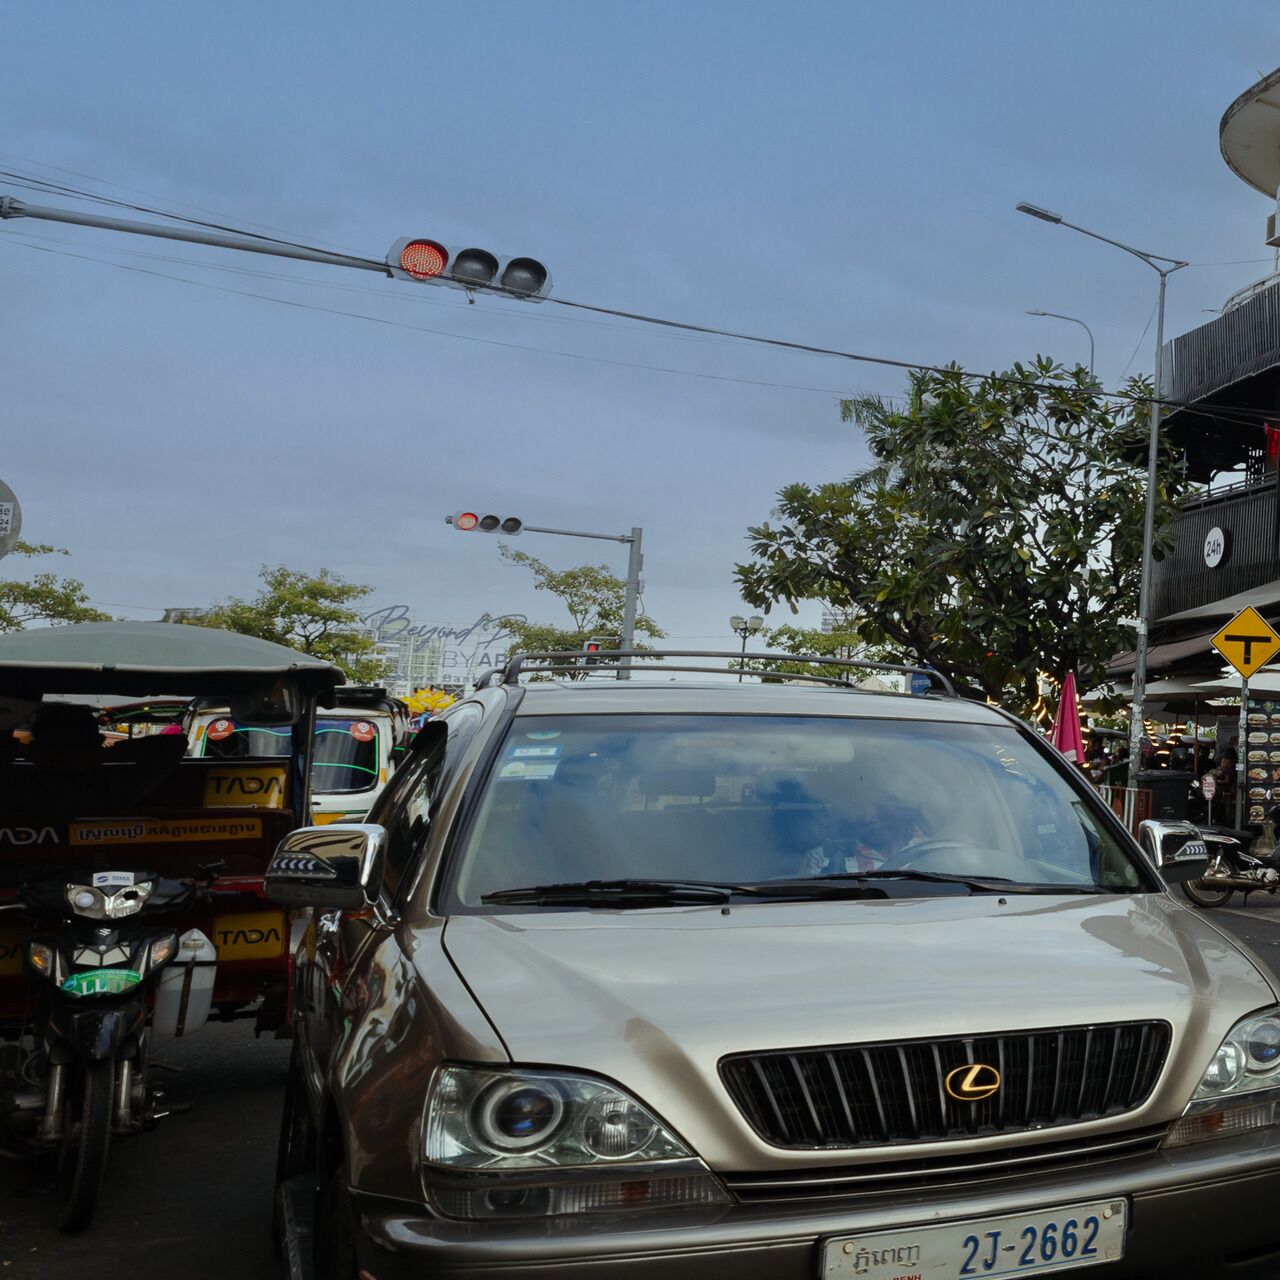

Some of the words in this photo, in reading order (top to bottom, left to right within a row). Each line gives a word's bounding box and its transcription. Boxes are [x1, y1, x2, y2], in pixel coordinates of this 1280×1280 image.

[1206, 538, 1221, 558] 24h
[360, 605, 492, 654] Beyond
[209, 776, 284, 795] TADA
[0, 826, 61, 846] ADA
[218, 928, 281, 944] TADA
[959, 1215, 1100, 1276] 2J-2662
[853, 1243, 920, 1275] ភ្នំពេញ
